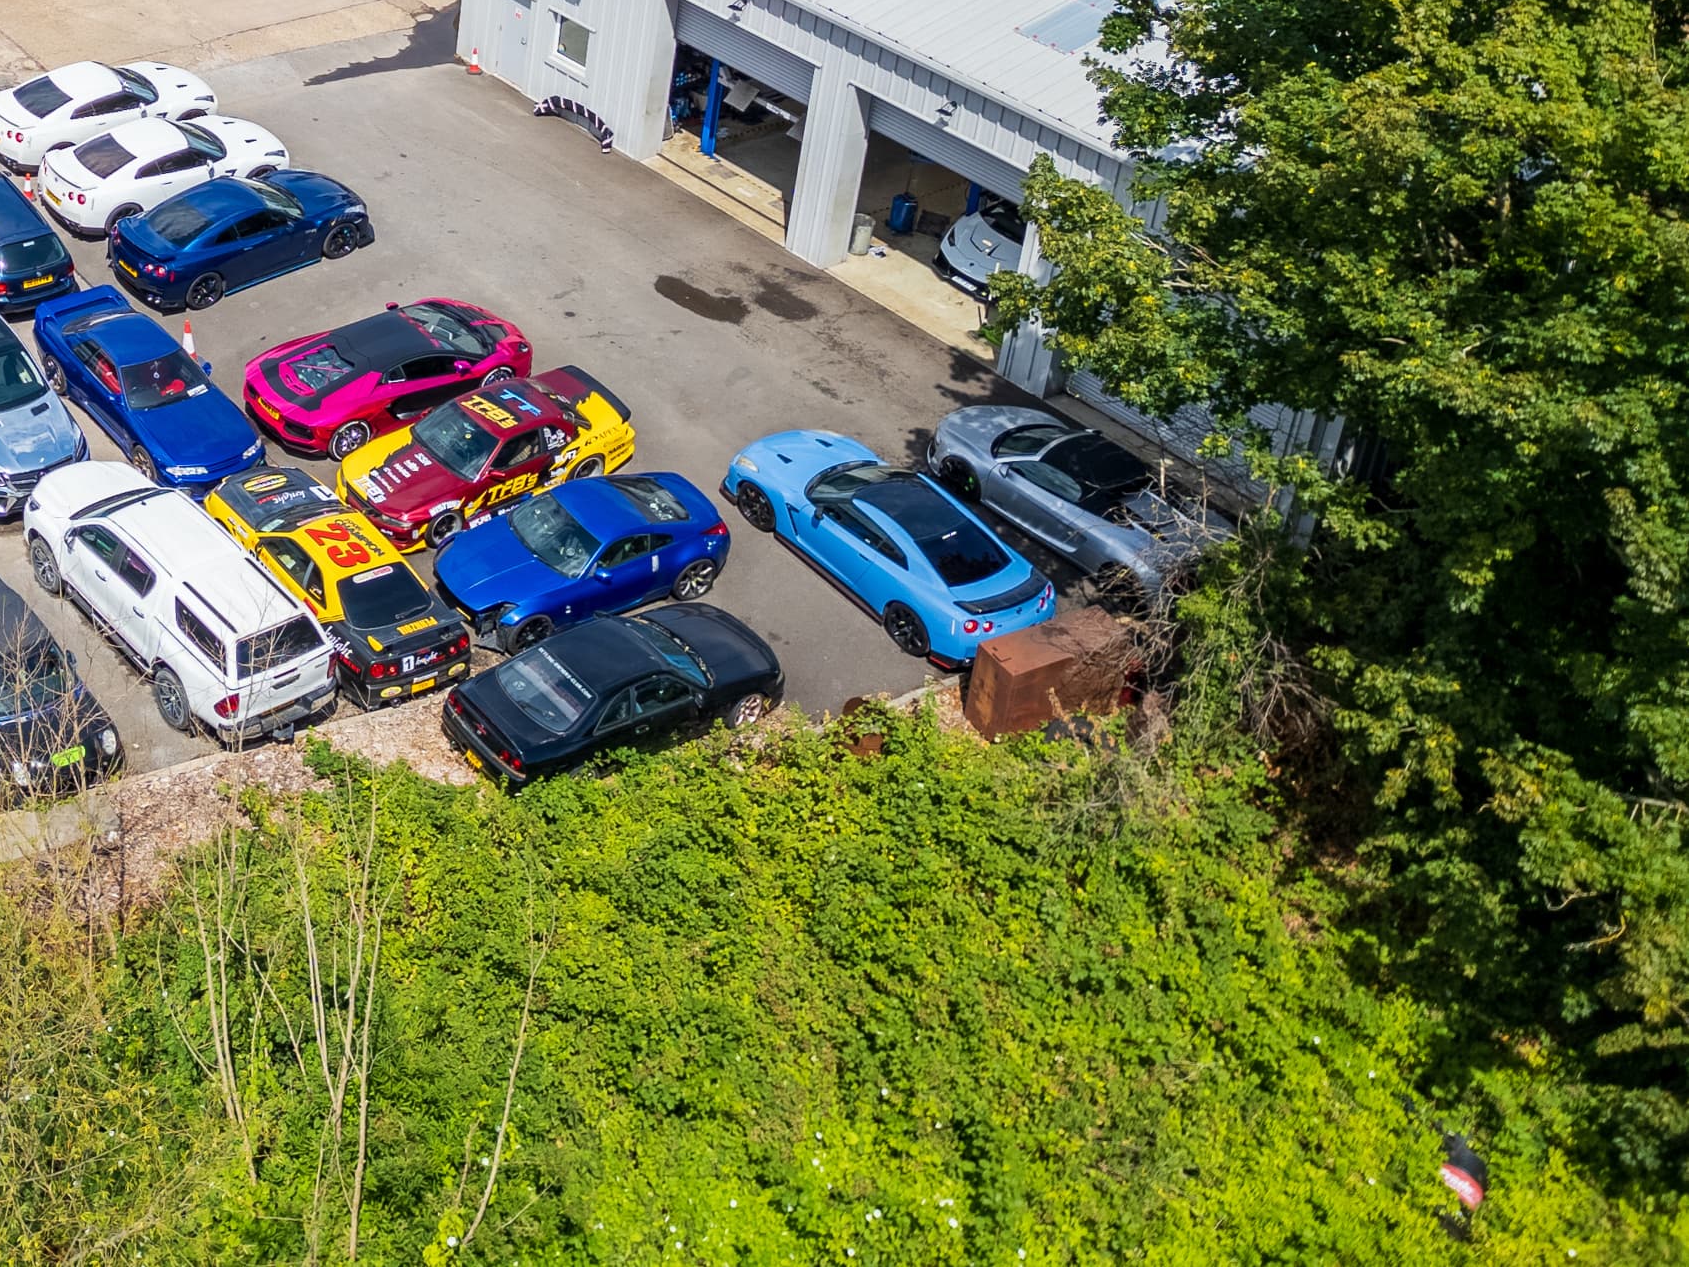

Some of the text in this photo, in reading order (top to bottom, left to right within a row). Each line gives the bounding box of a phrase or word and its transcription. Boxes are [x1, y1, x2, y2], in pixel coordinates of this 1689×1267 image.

[486, 471, 539, 507] TFB's
[305, 522, 371, 568] 23
[334, 519, 385, 557] CHAMPION
